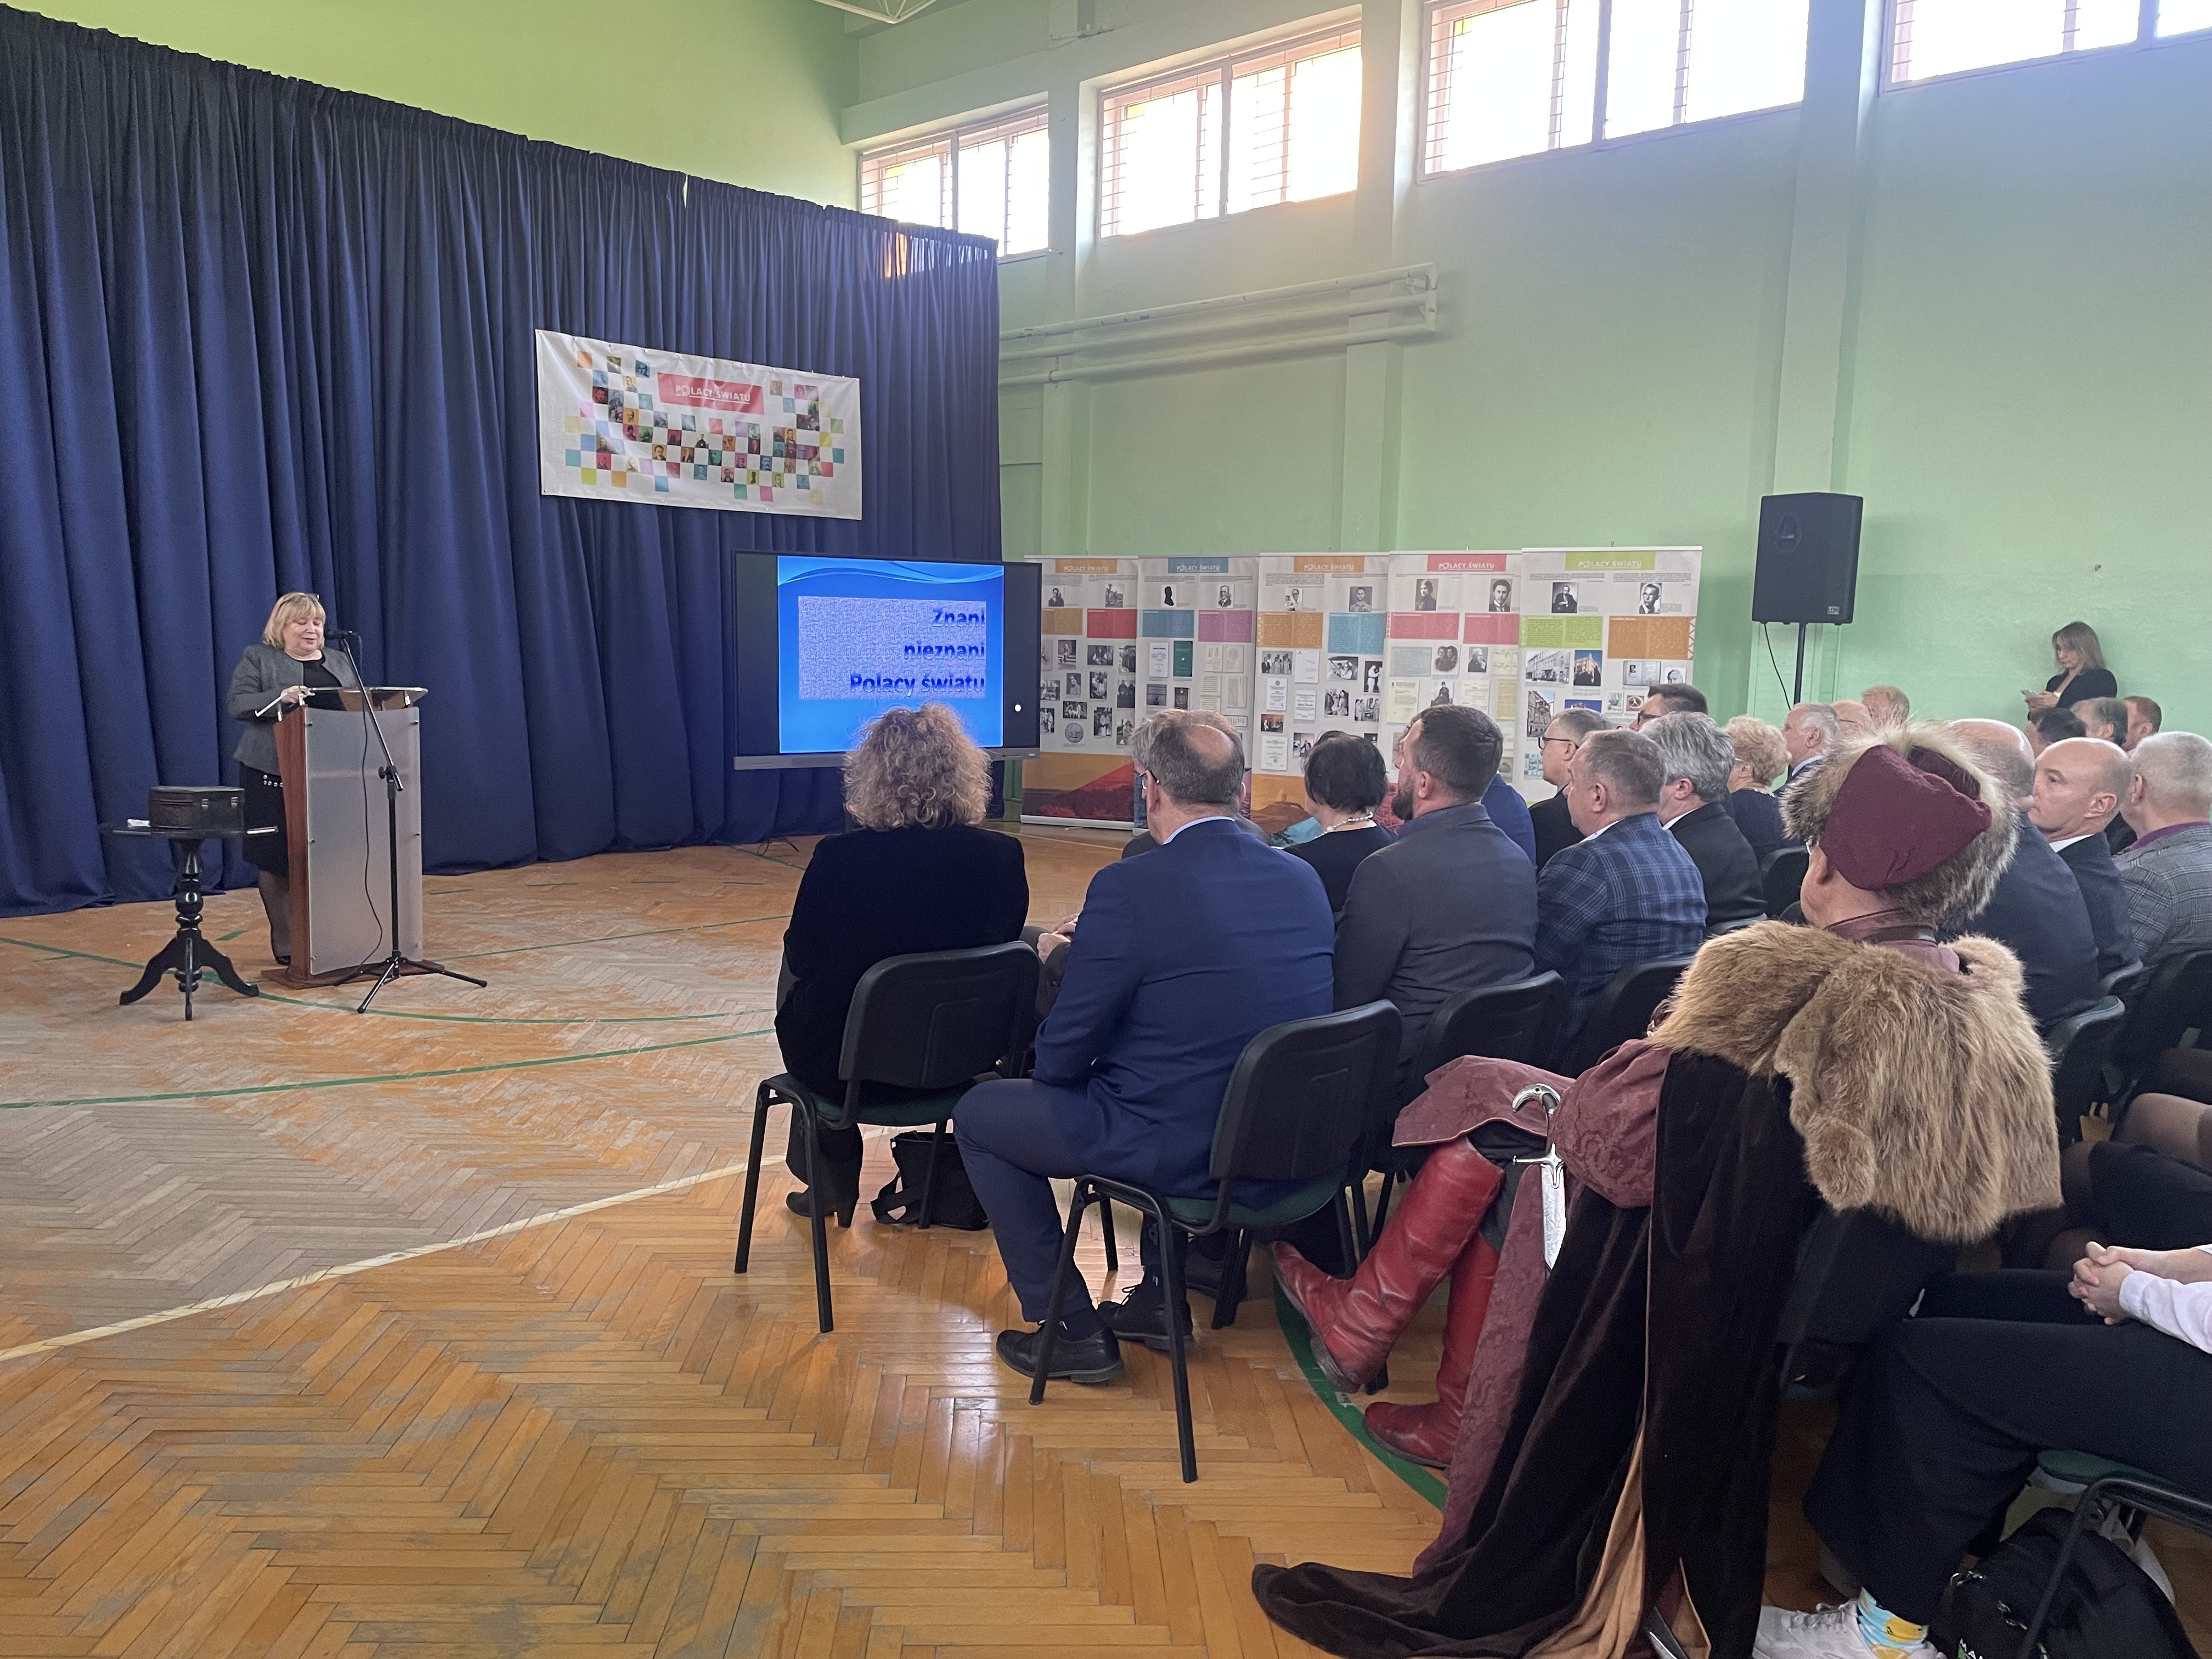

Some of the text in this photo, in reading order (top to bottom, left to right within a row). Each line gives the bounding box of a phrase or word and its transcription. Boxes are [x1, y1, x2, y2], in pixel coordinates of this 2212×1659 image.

[675, 385, 751, 402] POLACY ŚWIATU
[933, 608, 985, 627] Znani
[904, 640, 985, 659] nieznani
[850, 672, 985, 697] Polacy światu
